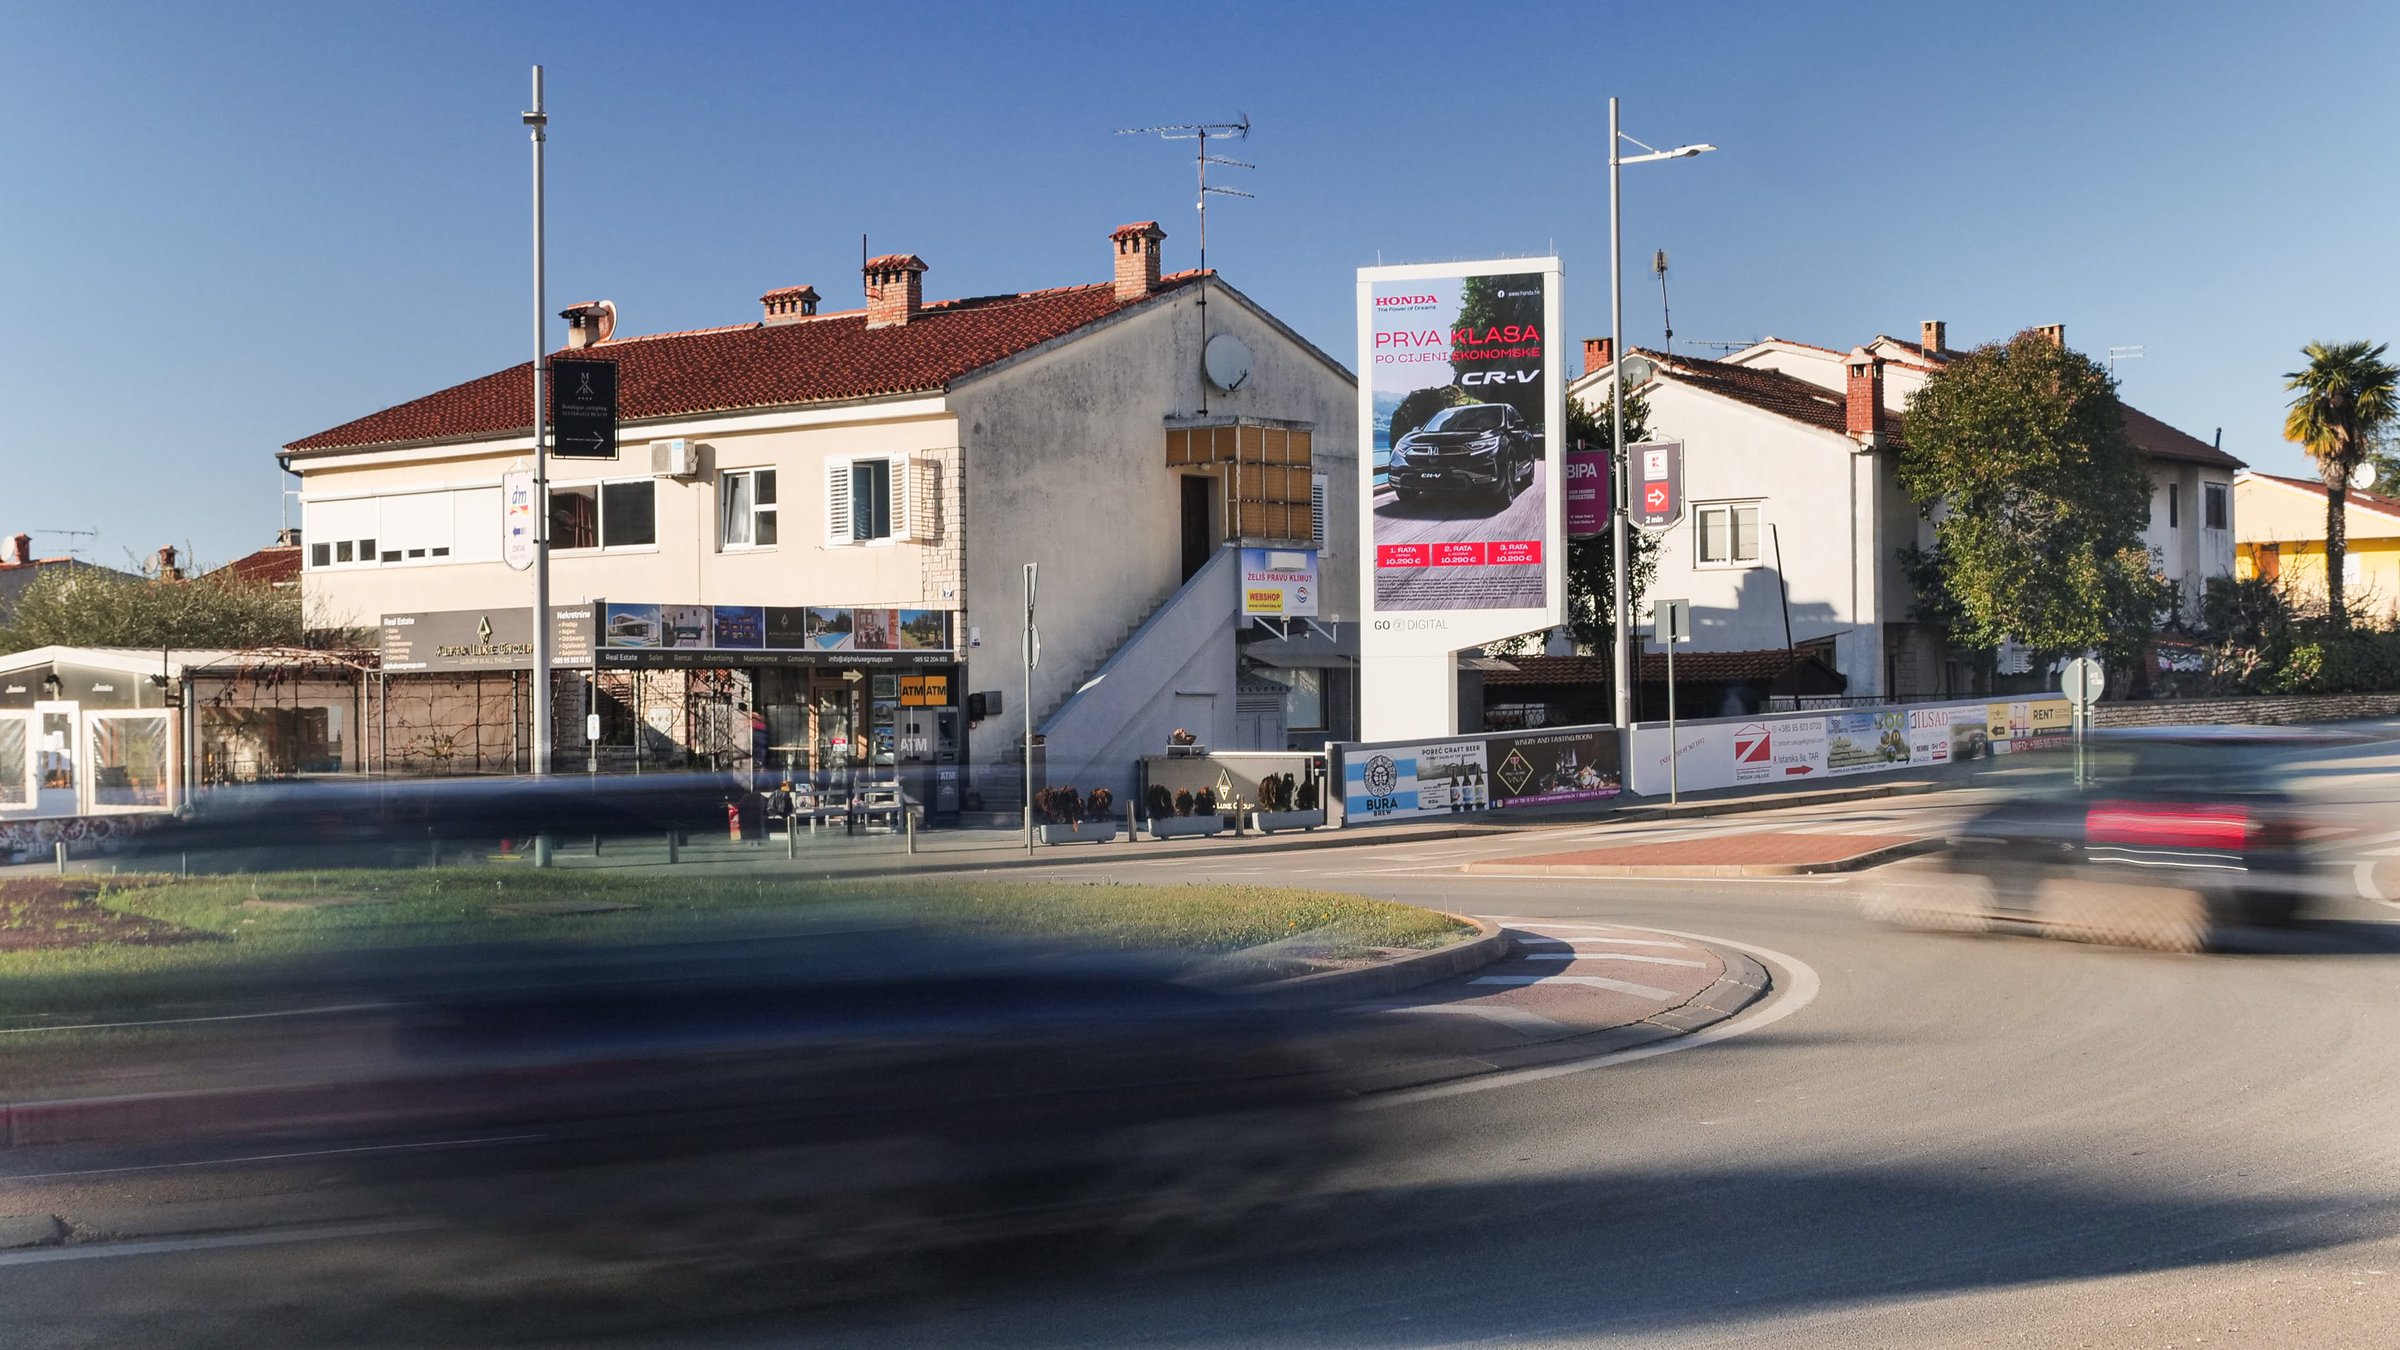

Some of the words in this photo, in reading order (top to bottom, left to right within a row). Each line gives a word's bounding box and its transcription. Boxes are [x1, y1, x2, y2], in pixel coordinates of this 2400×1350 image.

[1375, 295, 1438, 306] HONDA
[1376, 330, 1443, 348] PRVA
[1451, 325, 1541, 346] KLASA
[1376, 354, 1395, 364] PO
[1398, 352, 1448, 363] CIJENI
[1451, 348, 1541, 362] EKONOMSKE
[1462, 370, 1541, 386] CR-V
[1567, 463, 1597, 479] BIPA
[512, 485, 527, 504] dm
[1646, 516, 1651, 524] 2
[1249, 593, 1280, 601] WEBSHOP
[557, 611, 591, 620] Nekretnine
[384, 618, 396, 626] Real
[397, 617, 415, 625] Estate
[1374, 620, 1391, 631] GO
[1407, 619, 1449, 630] DIGITAL
[649, 654, 664, 662] Sales
[674, 654, 693, 662] Rental
[703, 655, 734, 663] Advertising
[743, 655, 778, 663] Maintenance
[788, 655, 816, 664] Consulting
[902, 686, 924, 696] ATM
[926, 686, 947, 696] ATM
[2033, 709, 2055, 721] RENT
[1779, 724, 1791, 733] +385
[1792, 724, 1798, 732] 95
[900, 738, 928, 752] ATM
[2012, 741, 2029, 751] INFO:
[1422, 746, 1443, 755] POREČ
[1444, 746, 1464, 754] CRAFT
[1778, 754, 1798, 764] Istarska
[1809, 752, 1819, 761] TAR
[940, 772, 956, 780] ATM
[1216, 802, 1233, 810] LUXE
[1366, 798, 1399, 811] BURA
